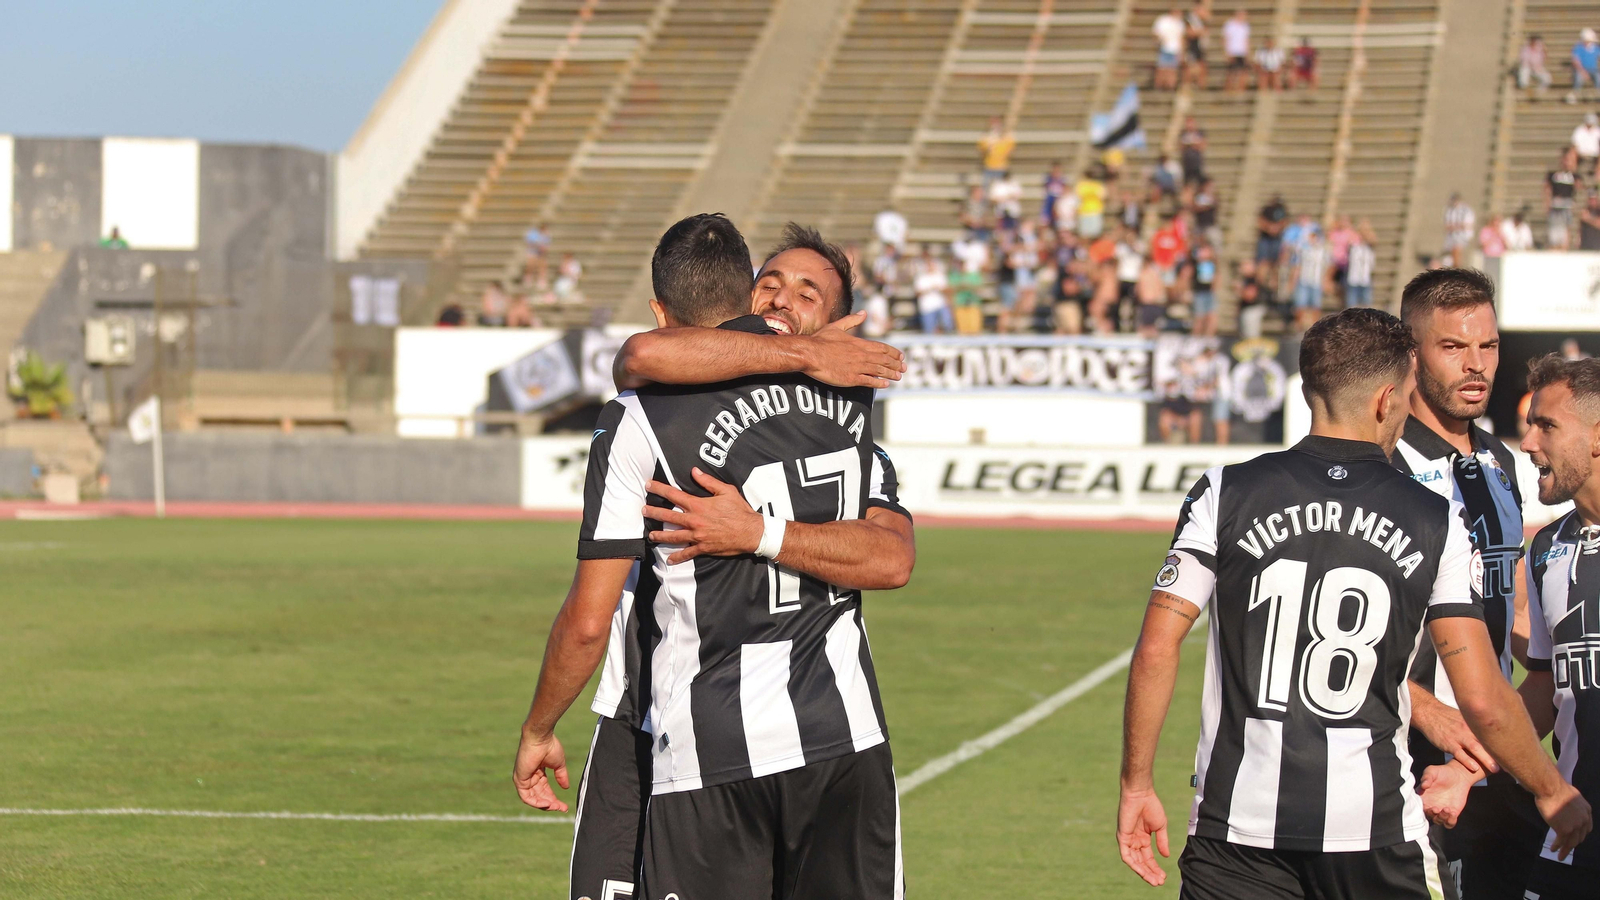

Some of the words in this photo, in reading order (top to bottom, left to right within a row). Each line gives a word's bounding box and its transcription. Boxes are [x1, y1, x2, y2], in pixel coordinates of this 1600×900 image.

[699, 384, 790, 468] GERARD
[795, 384, 866, 444] OLIVA
[941, 460, 1121, 493] LEGEA
[1140, 462, 1212, 493] LE
[1409, 469, 1443, 483] GEA
[741, 446, 863, 615] 17
[1236, 501, 1342, 560] VÍCTOR
[1348, 507, 1425, 580] MENA
[1534, 545, 1569, 567] LEGEA
[1247, 557, 1392, 720] 18
